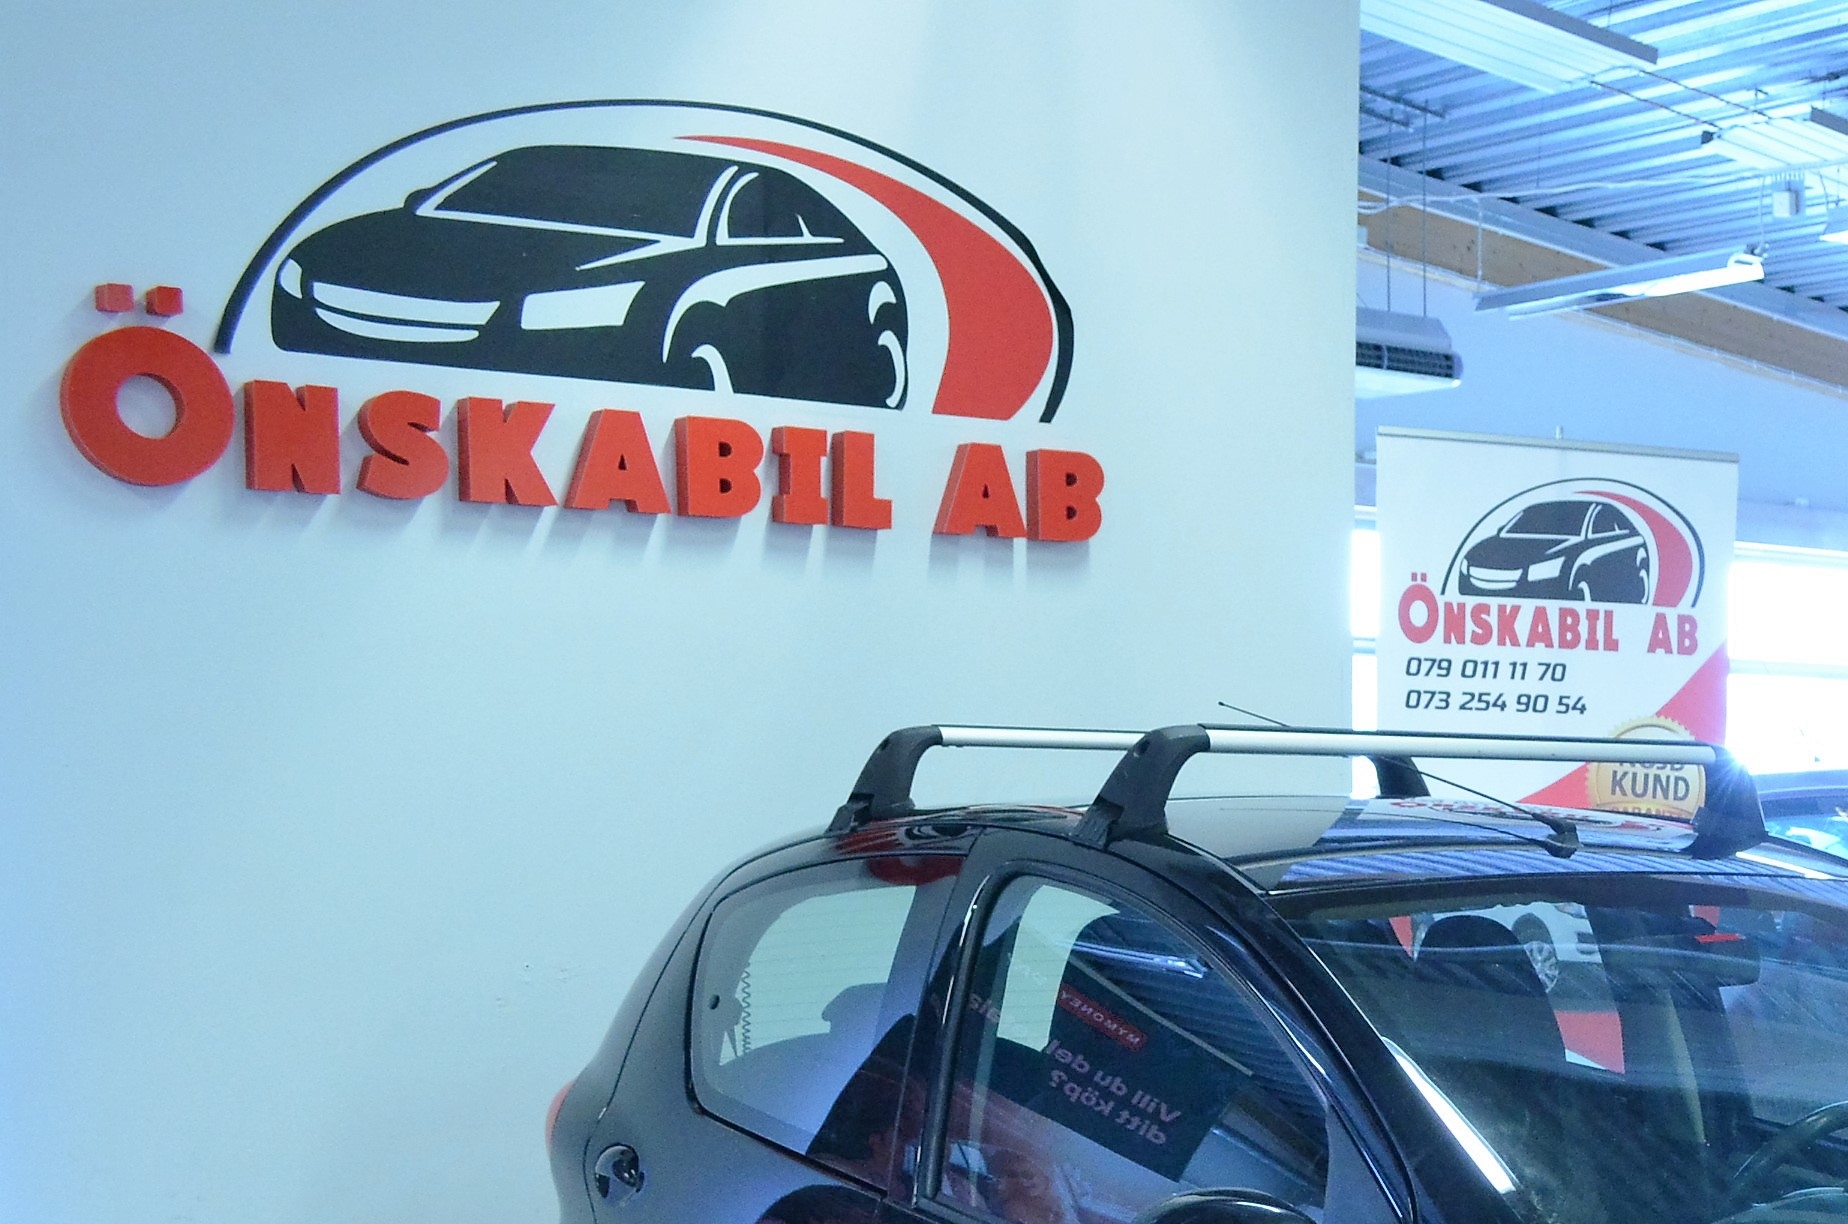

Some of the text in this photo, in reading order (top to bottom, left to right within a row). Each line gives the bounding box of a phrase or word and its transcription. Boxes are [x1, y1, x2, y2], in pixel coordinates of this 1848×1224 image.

[60, 282, 1104, 542] ÖNSKABIL AB
[1398, 572, 1698, 656] ÖNSKABIL AB
[1405, 657, 1567, 682] 079 011 11 70
[1405, 690, 1587, 715] 073 254 90 54
[1611, 769, 1690, 801] KUND
